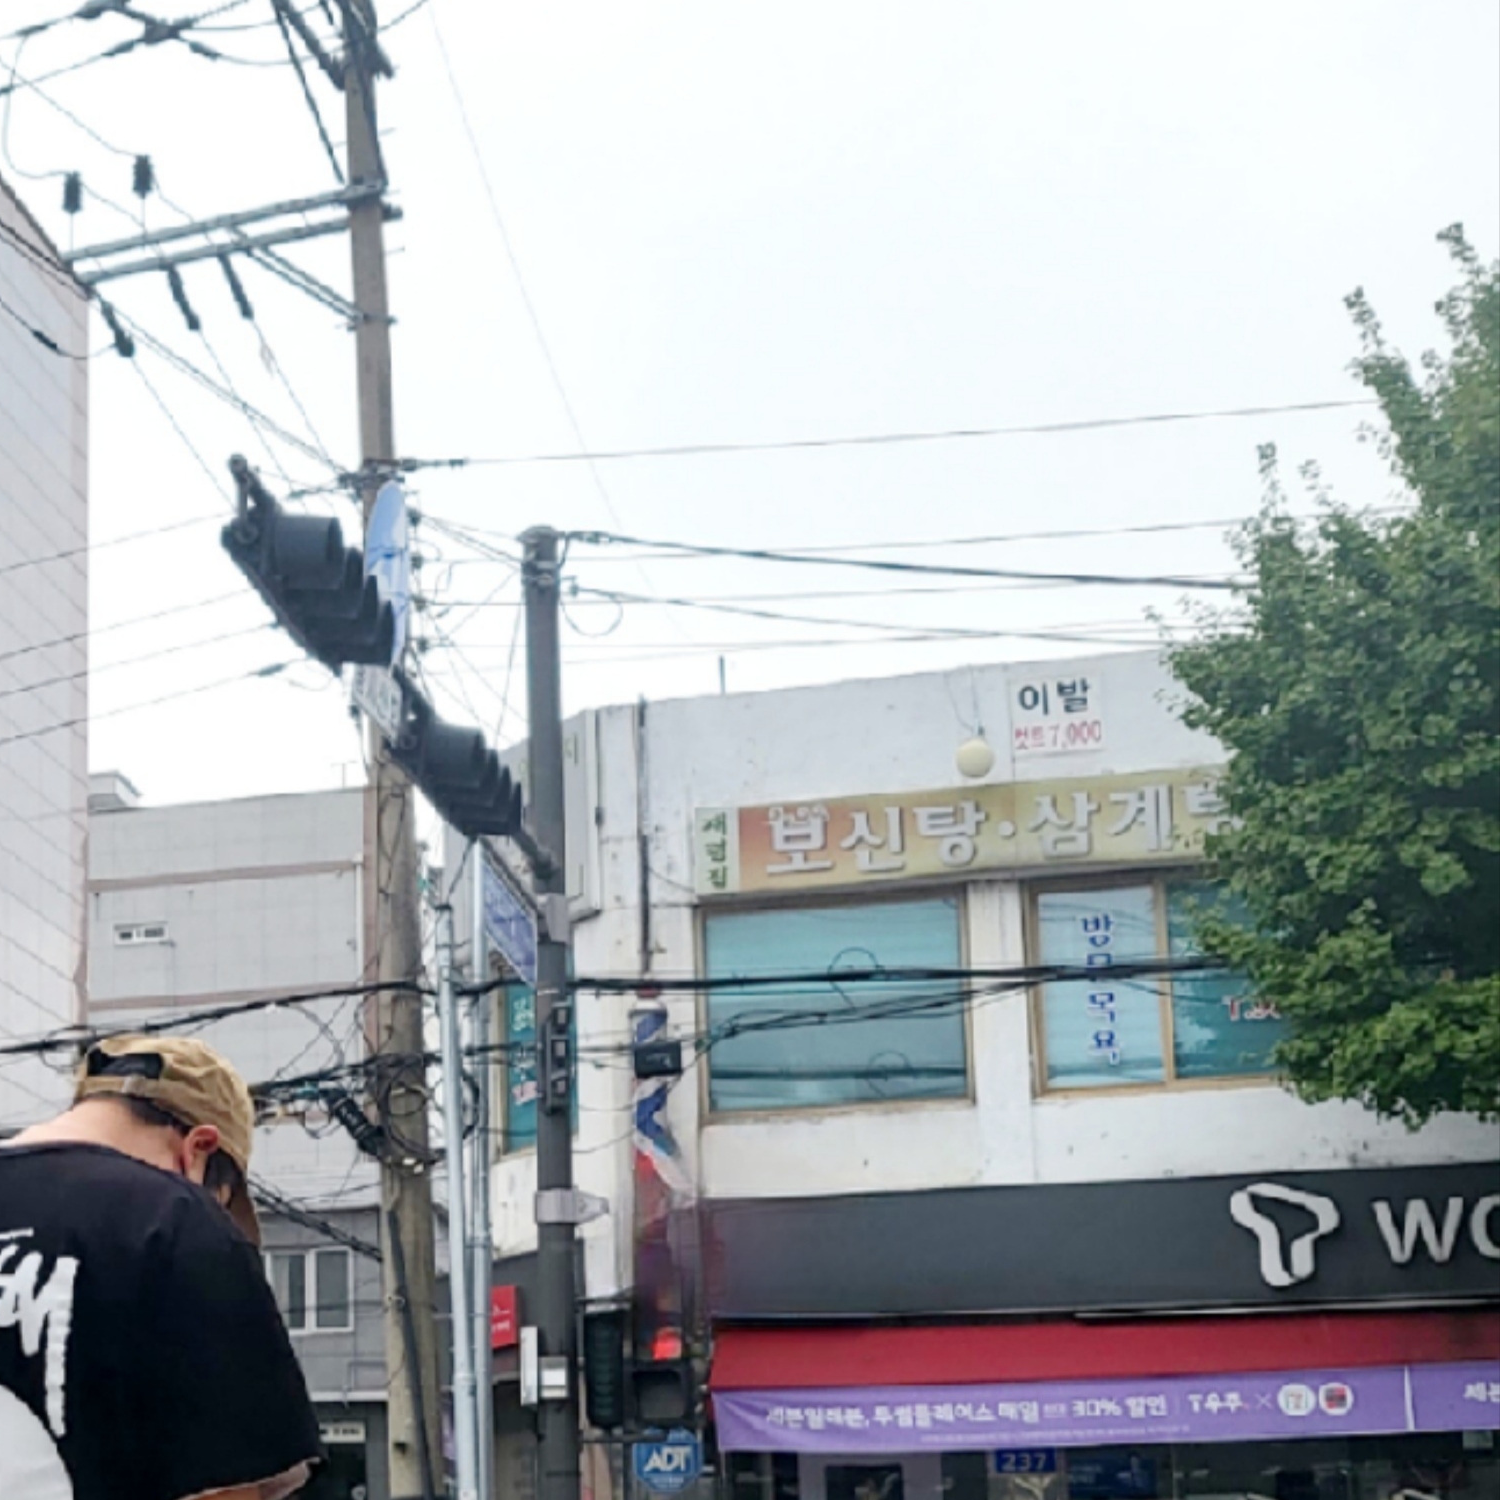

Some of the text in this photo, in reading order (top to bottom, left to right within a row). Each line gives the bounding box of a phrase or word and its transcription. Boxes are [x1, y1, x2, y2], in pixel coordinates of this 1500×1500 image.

[1017, 676, 1092, 716] 이발
[643, 1445, 691, 1473] ADT
[1000, 1452, 1047, 1473] 237
